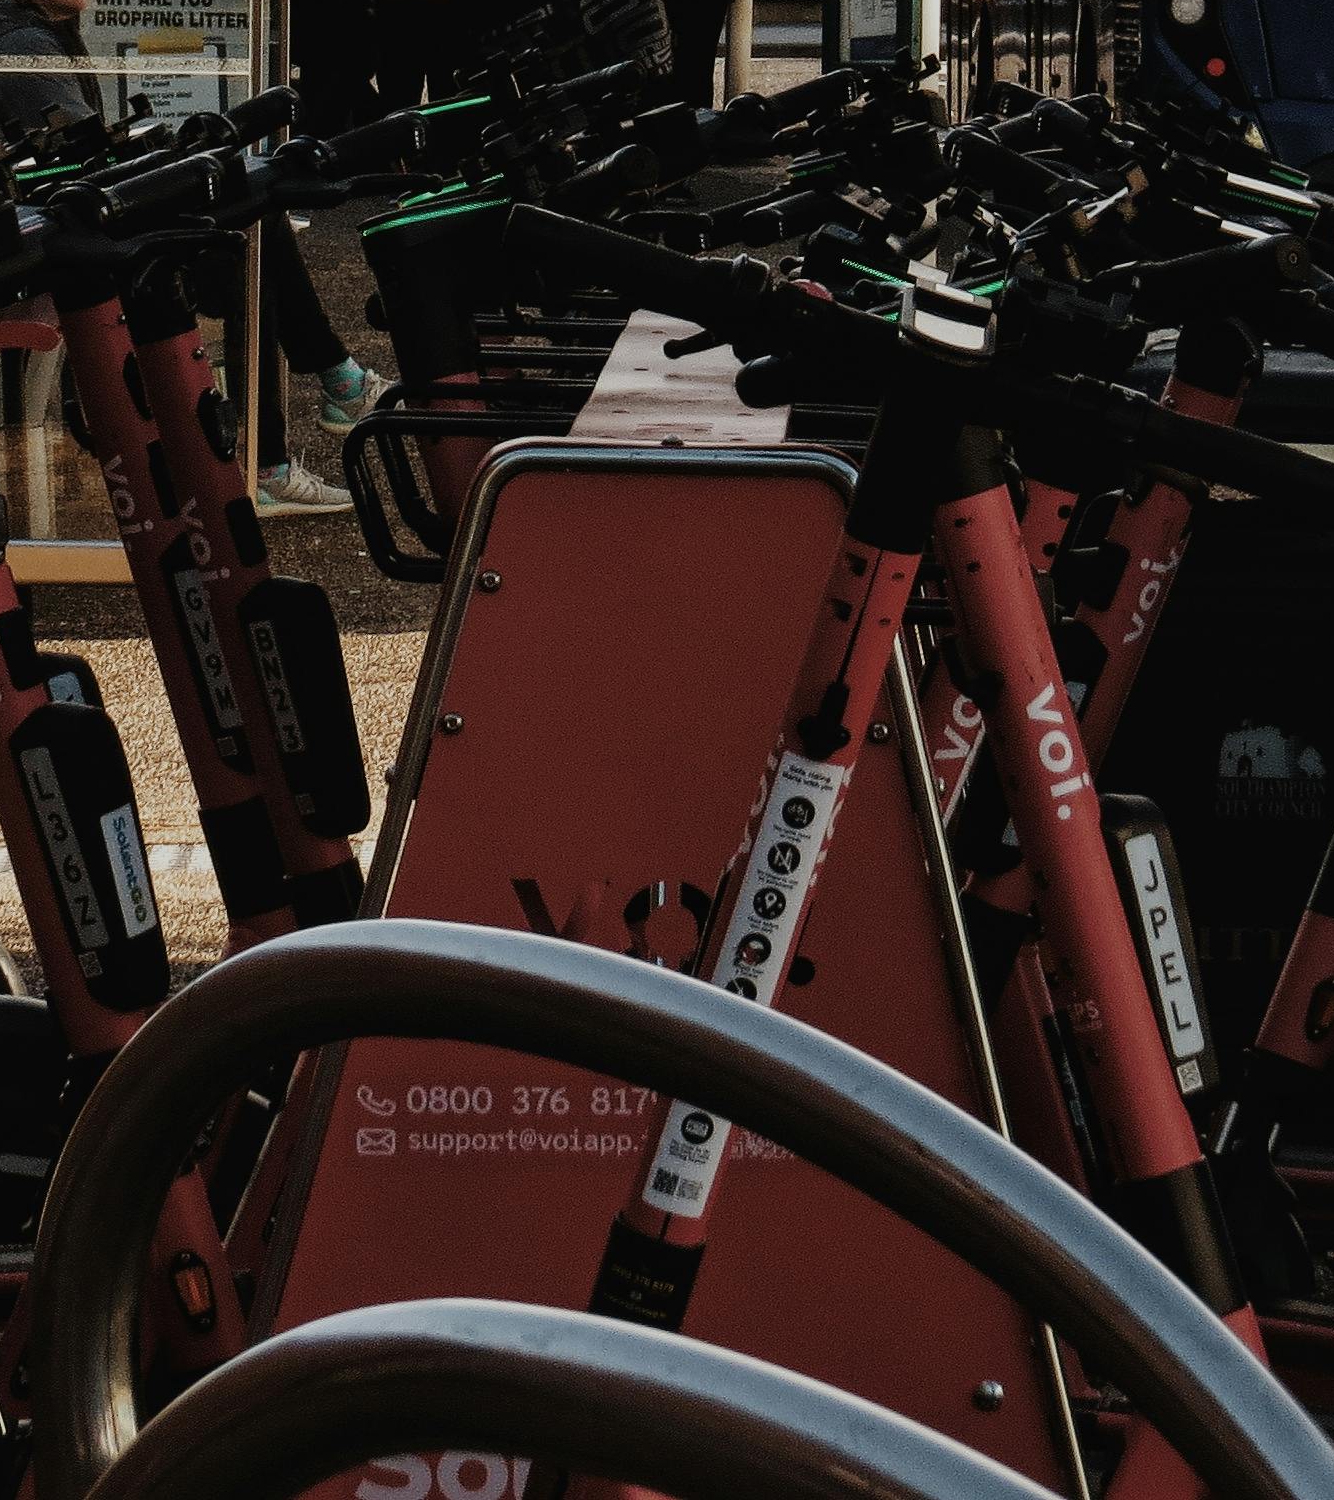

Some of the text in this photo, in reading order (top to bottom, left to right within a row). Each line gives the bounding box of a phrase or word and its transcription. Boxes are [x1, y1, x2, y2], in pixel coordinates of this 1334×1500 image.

[94, 11, 249, 29] DROPPING LITTER
[1026, 681, 1093, 821] voi.
[31, 767, 98, 926] L36Z
[1145, 859, 1191, 1032] JPEL
[405, 1085, 659, 1116] 0800 376 817
